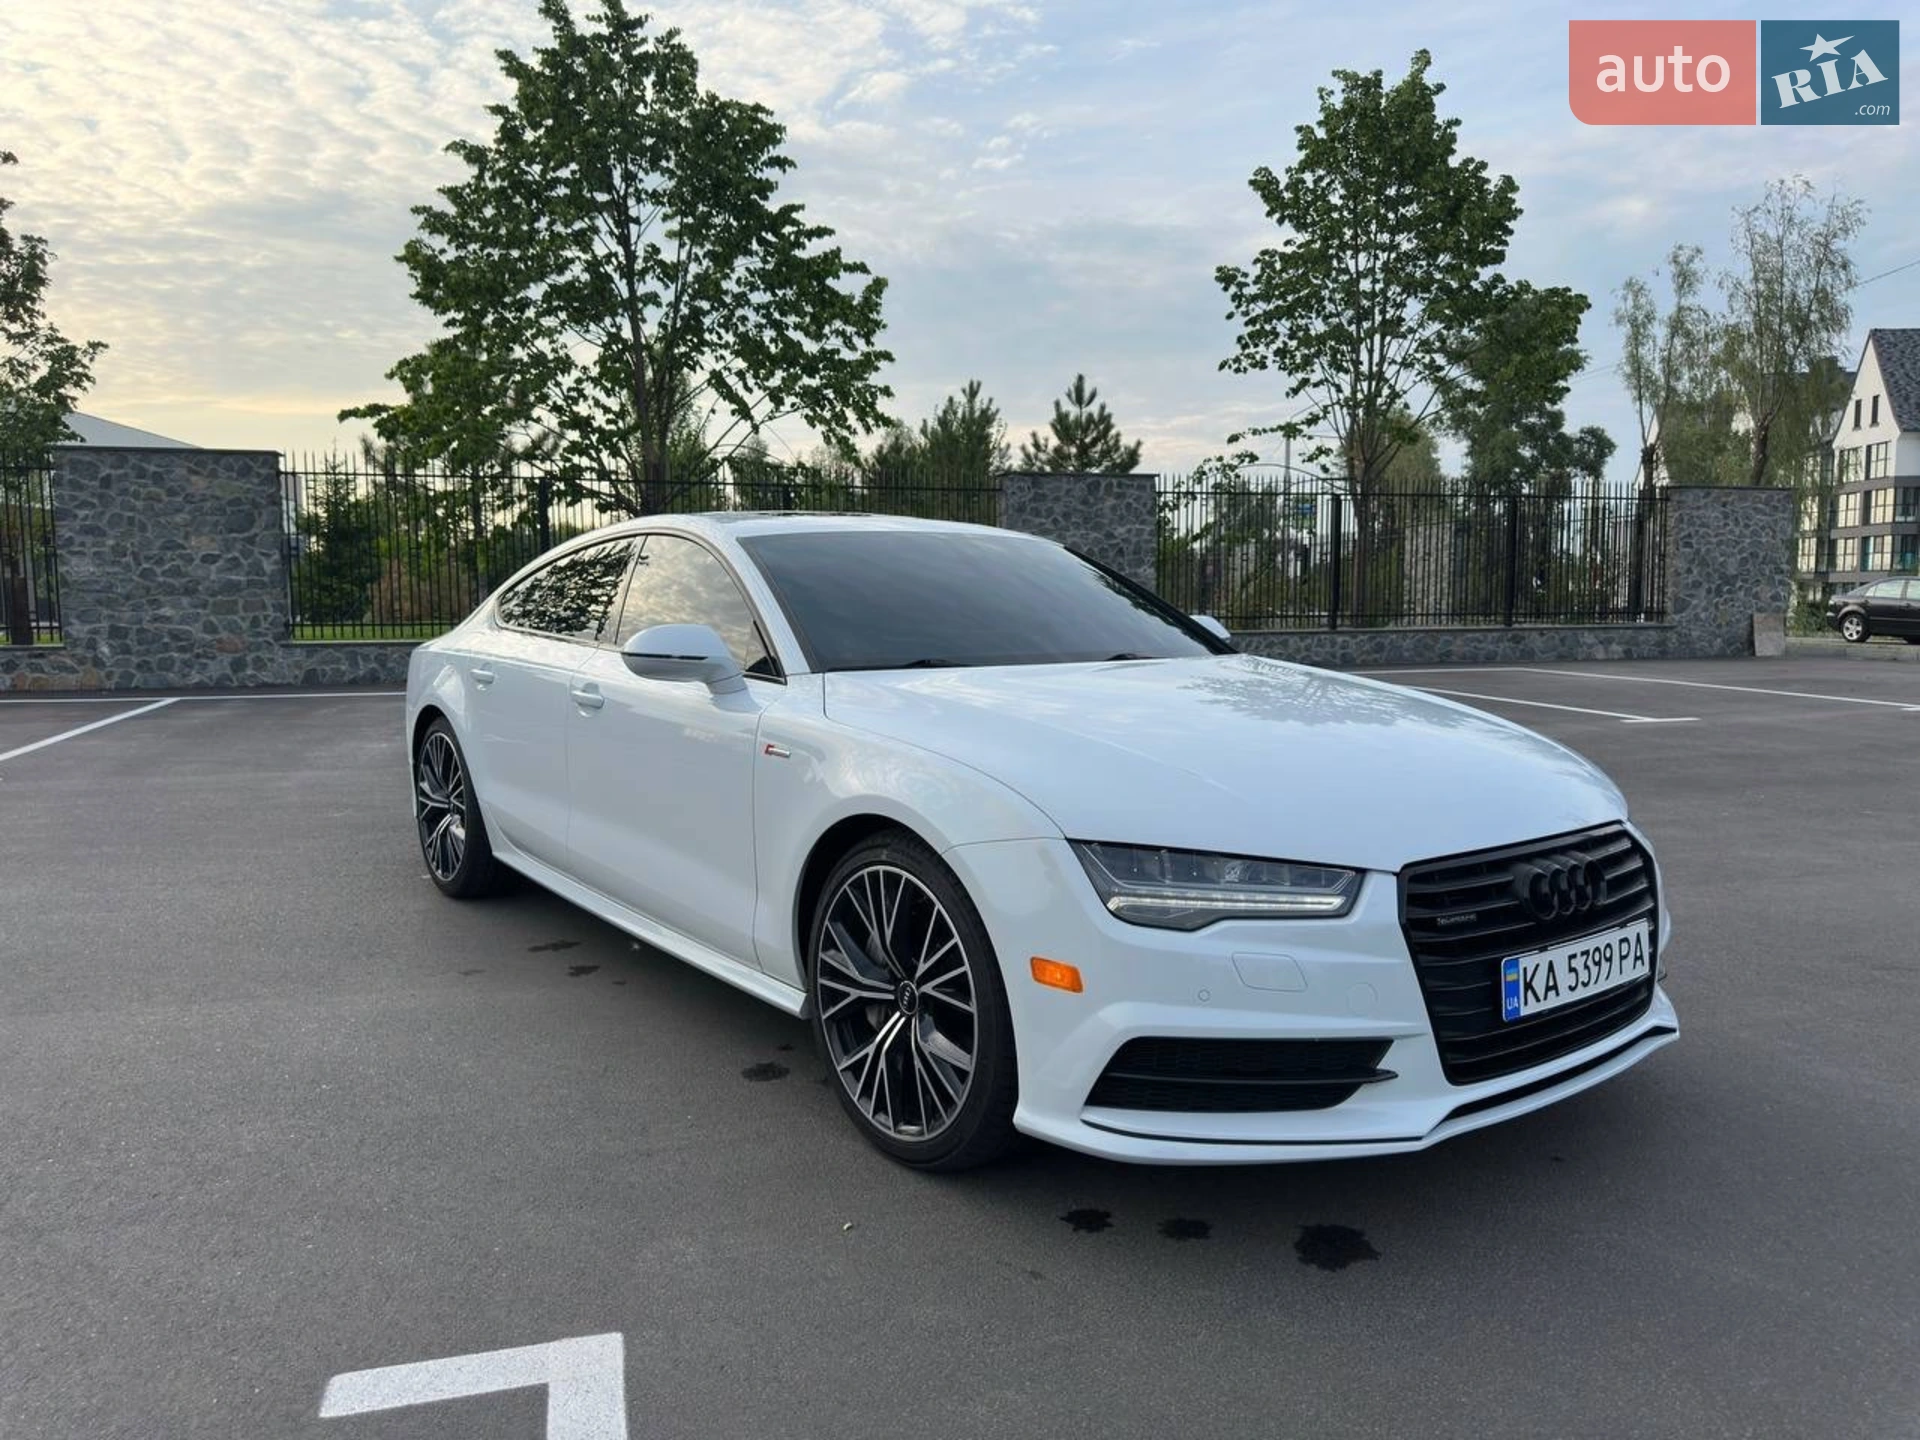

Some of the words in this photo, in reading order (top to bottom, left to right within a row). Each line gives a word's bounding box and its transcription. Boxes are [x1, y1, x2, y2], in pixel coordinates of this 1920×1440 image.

[1523, 959, 1560, 1006] KA
[1567, 943, 1613, 992] 5399
[1618, 932, 1645, 975] PA
[1507, 997, 1519, 1010] UA
